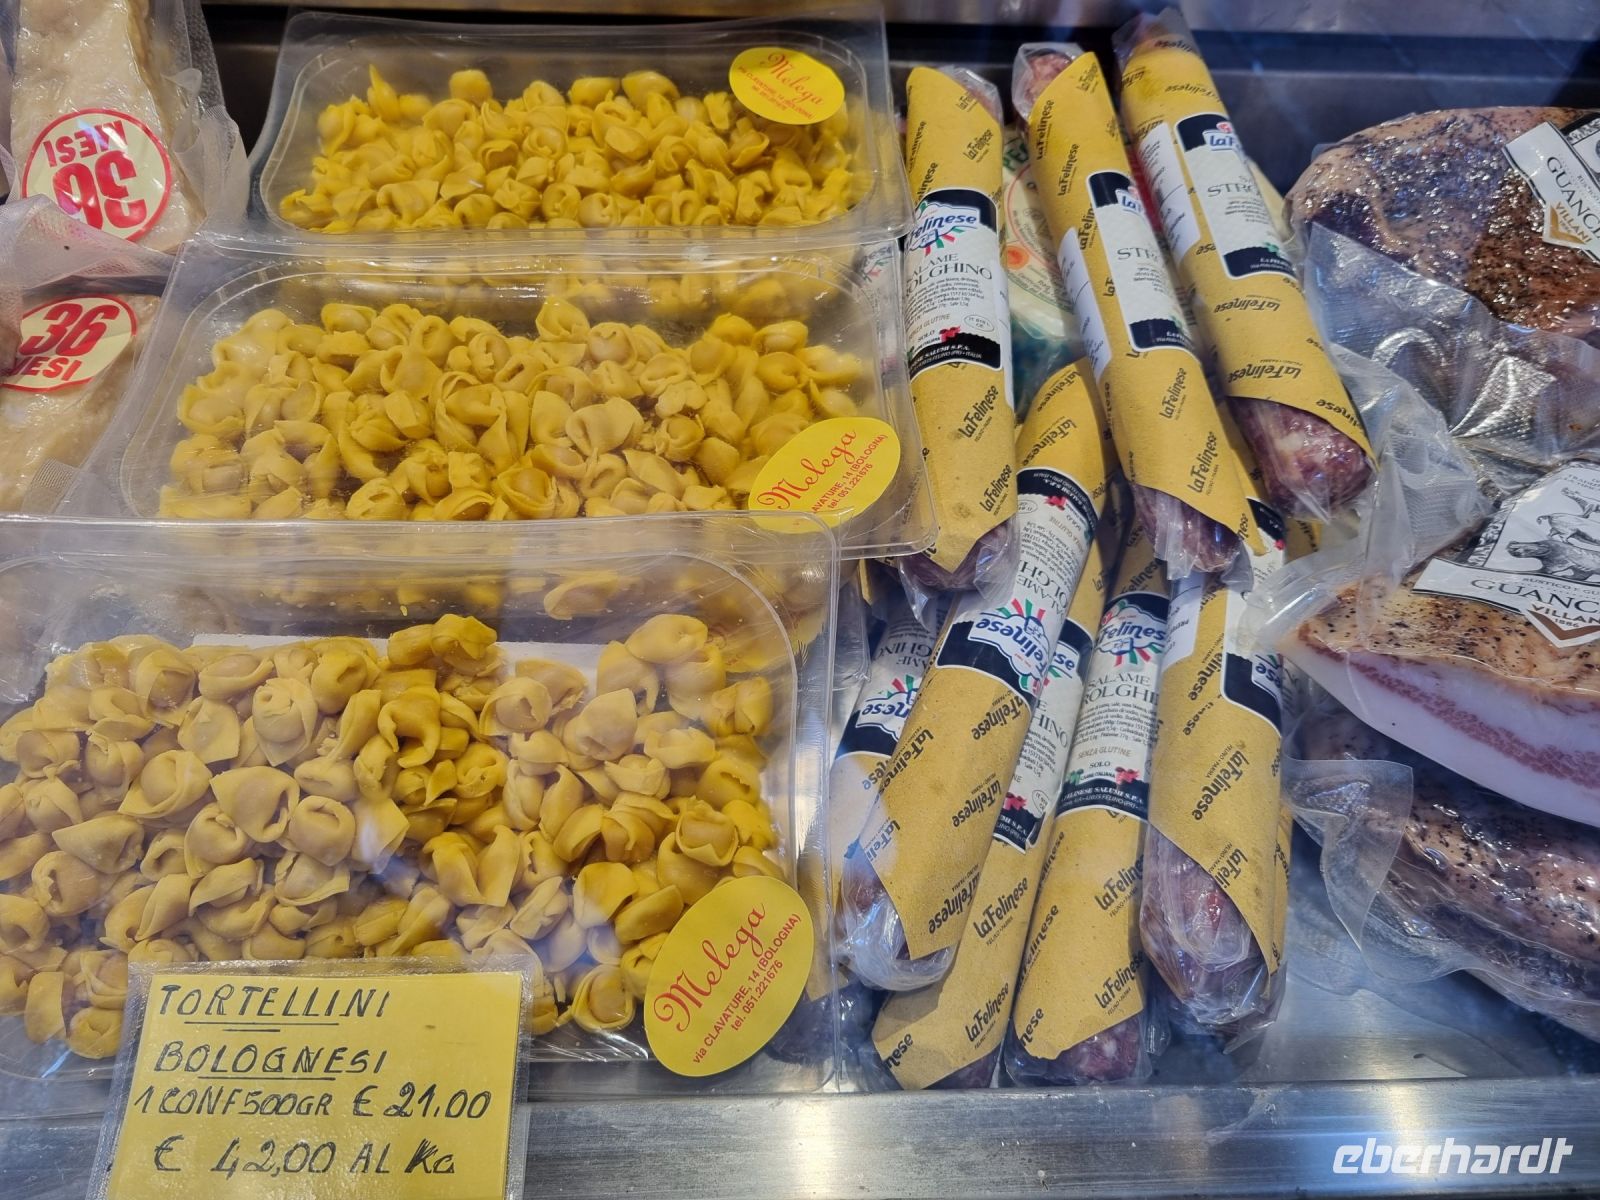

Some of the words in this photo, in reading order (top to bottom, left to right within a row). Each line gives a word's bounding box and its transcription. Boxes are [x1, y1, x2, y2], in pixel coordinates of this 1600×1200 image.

[768, 53, 823, 104] Melega
[1556, 202, 1592, 243] VILLANI
[18, 303, 120, 356] 36
[756, 431, 857, 511] Melega
[851, 434, 889, 473] (BOLOGNA)
[828, 495, 841, 510] tel.
[653, 903, 766, 1033] Melega
[693, 1047, 707, 1064] via
[704, 985, 754, 1048] CLAVATURE,
[748, 970, 760, 985] 14
[757, 913, 802, 972] (BOLOGNA)
[160, 983, 390, 1018] TORTELLINI
[731, 1015, 746, 1031] tel.
[743, 960, 784, 1015] 051.221676
[154, 1040, 388, 1075] BOLOGNESI
[353, 1085, 379, 1117] €
[154, 1134, 185, 1172] €
[210, 1136, 337, 1181] 42,00
[350, 1141, 391, 1174] AL
